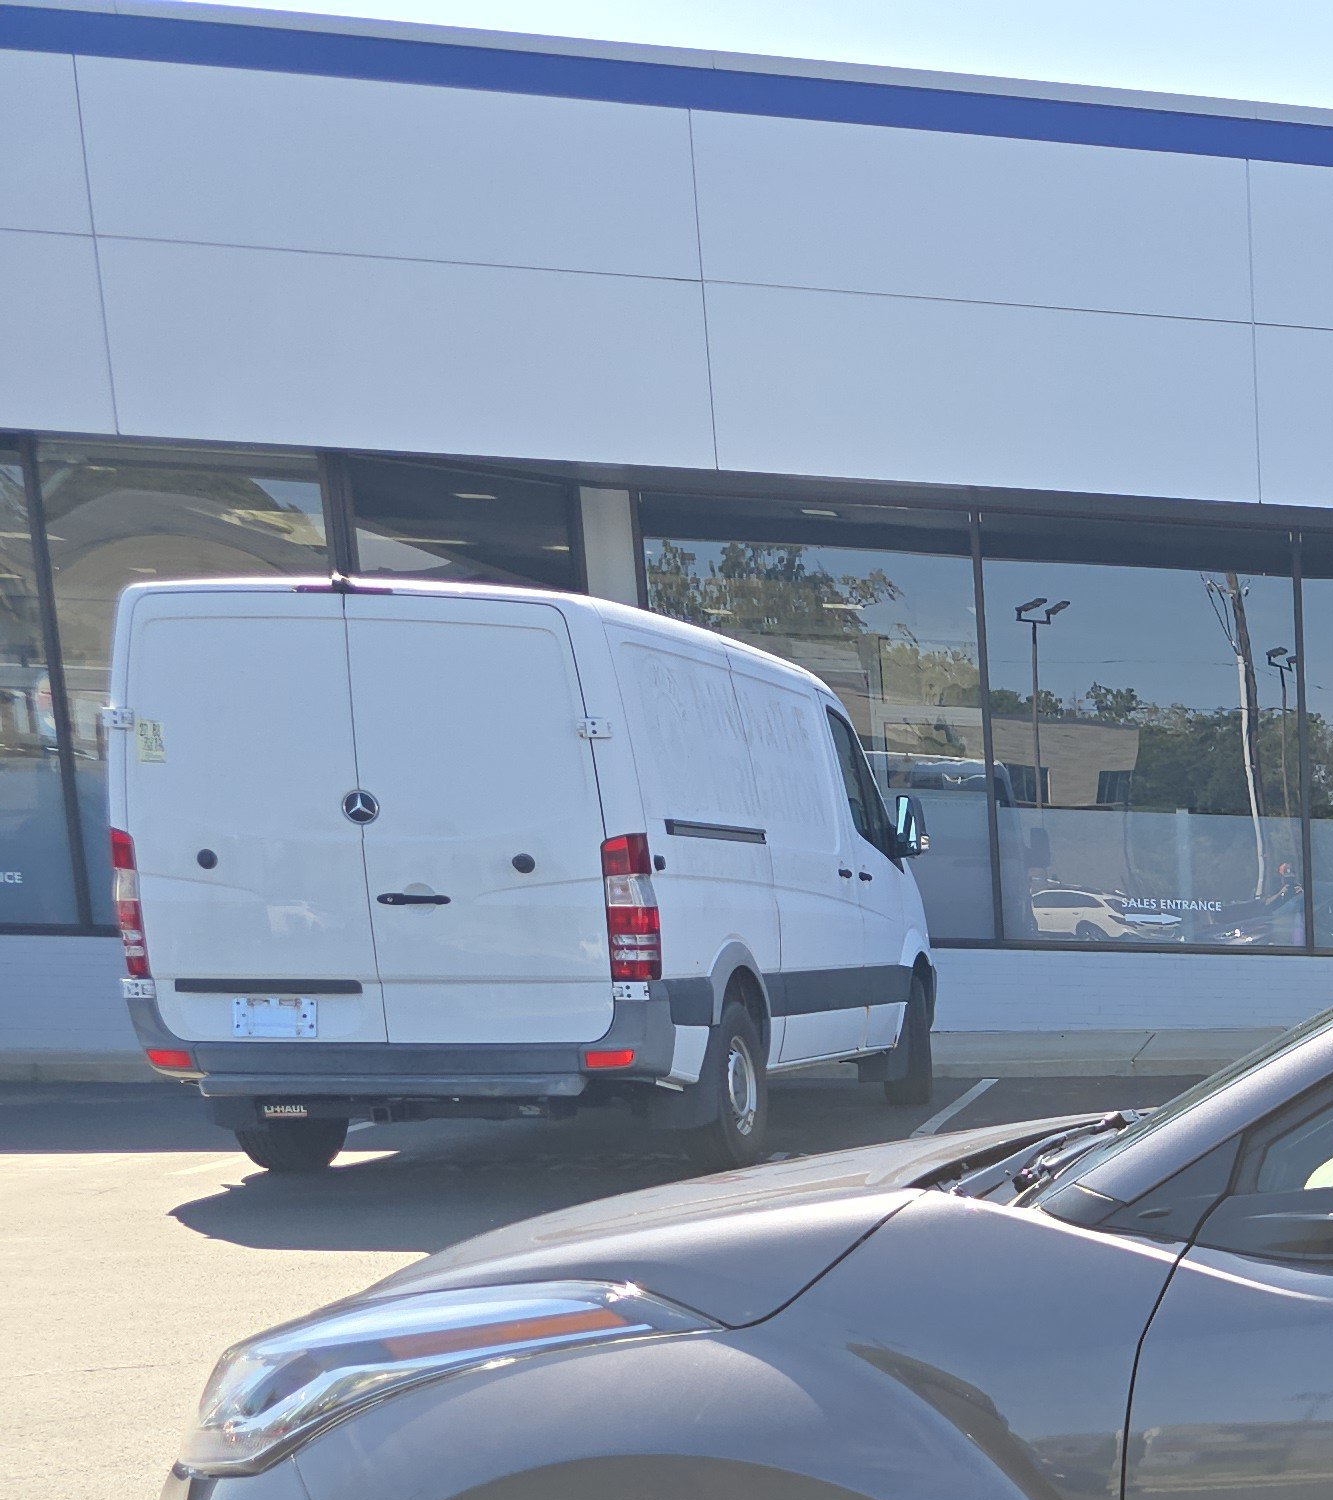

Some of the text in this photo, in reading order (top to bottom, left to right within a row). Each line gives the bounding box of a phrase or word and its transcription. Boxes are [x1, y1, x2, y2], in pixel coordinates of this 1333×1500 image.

[1121, 898, 1222, 911] SALES ENTRANCE
[264, 1105, 307, 1113] U-HAUL
